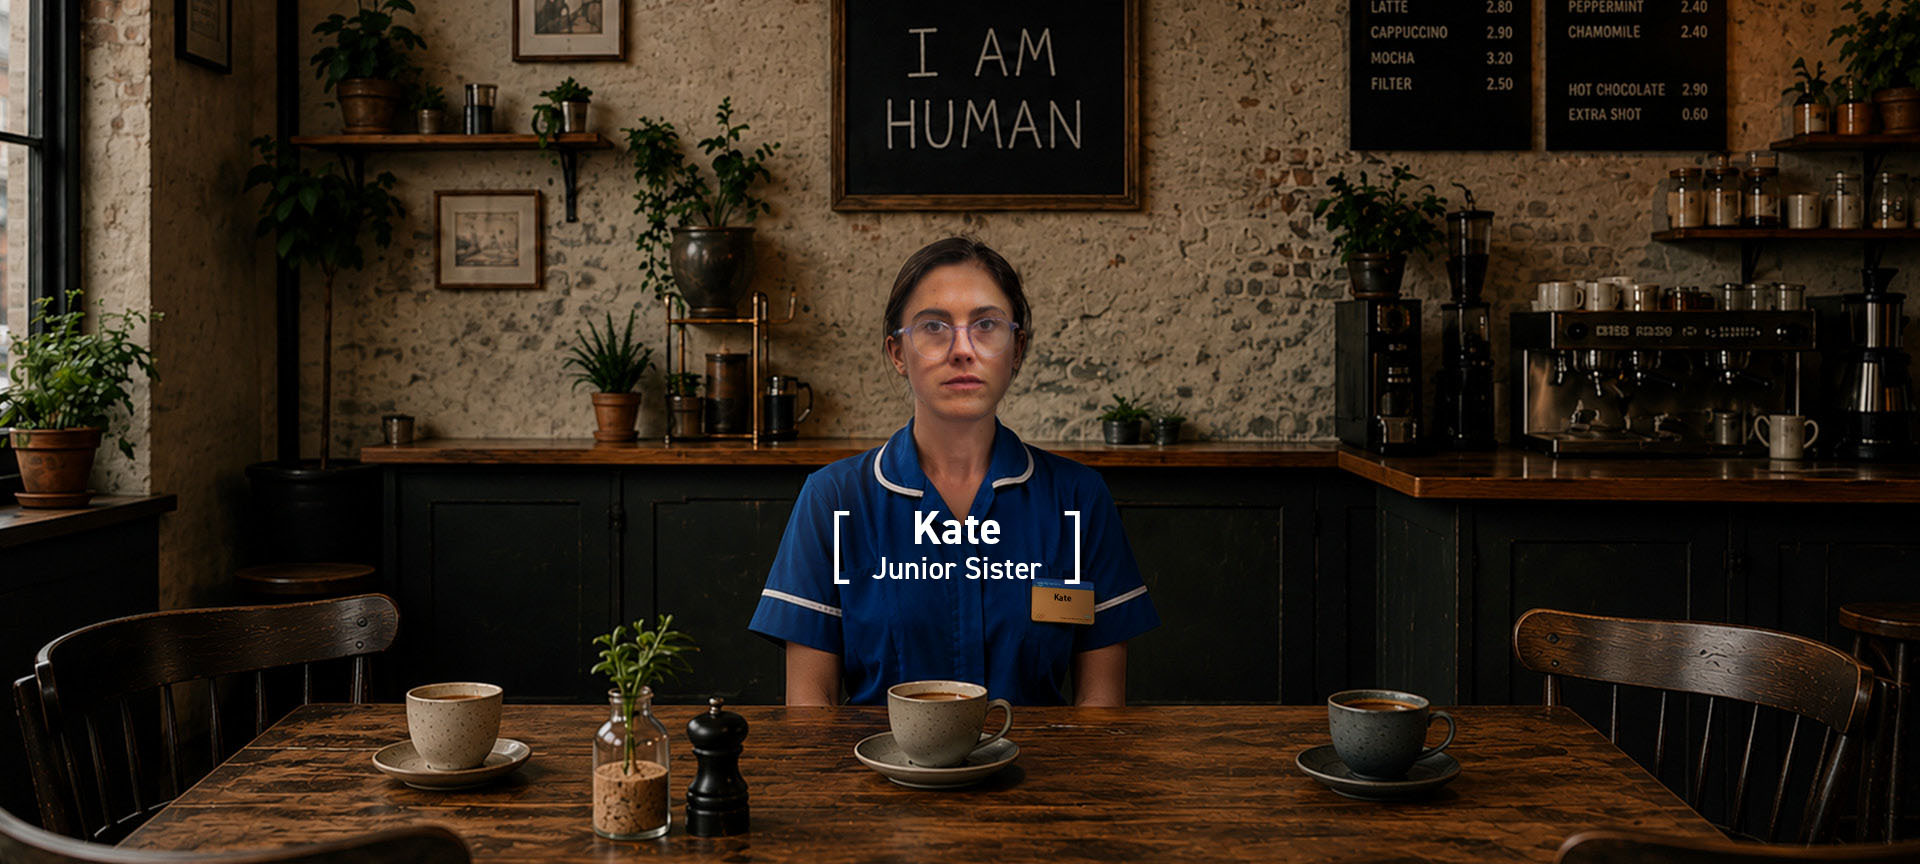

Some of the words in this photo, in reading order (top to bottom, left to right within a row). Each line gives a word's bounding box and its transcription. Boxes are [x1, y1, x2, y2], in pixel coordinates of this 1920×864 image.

[1371, 0, 1408, 14] LATTE
[1486, 0, 1513, 14] 2.80
[1568, 0, 1644, 13] PEPPERMINT
[1681, 0, 1708, 13] 2.40
[1370, 25, 1448, 39] CAPPUCCINO
[1487, 25, 1513, 39] 2.90
[1568, 24, 1641, 39] CHAMOMILE
[1680, 25, 1708, 38] 2.40
[907, 27, 938, 78] I
[974, 28, 1056, 77] AM
[1371, 51, 1415, 65] MOCHA
[1486, 51, 1513, 65] 3.20
[1371, 76, 1413, 91] FILTER
[1487, 77, 1514, 91] 2.50
[1568, 82, 1592, 97] HOT
[1596, 82, 1665, 97] CHOCOLATE
[1682, 82, 1708, 96] 2.90
[1568, 107, 1607, 121] EXTRA
[1610, 107, 1642, 121] SHOT
[1682, 107, 1708, 121] 0.60
[887, 98, 1082, 150] HUMAN
[1053, 593, 1072, 602] Kate
